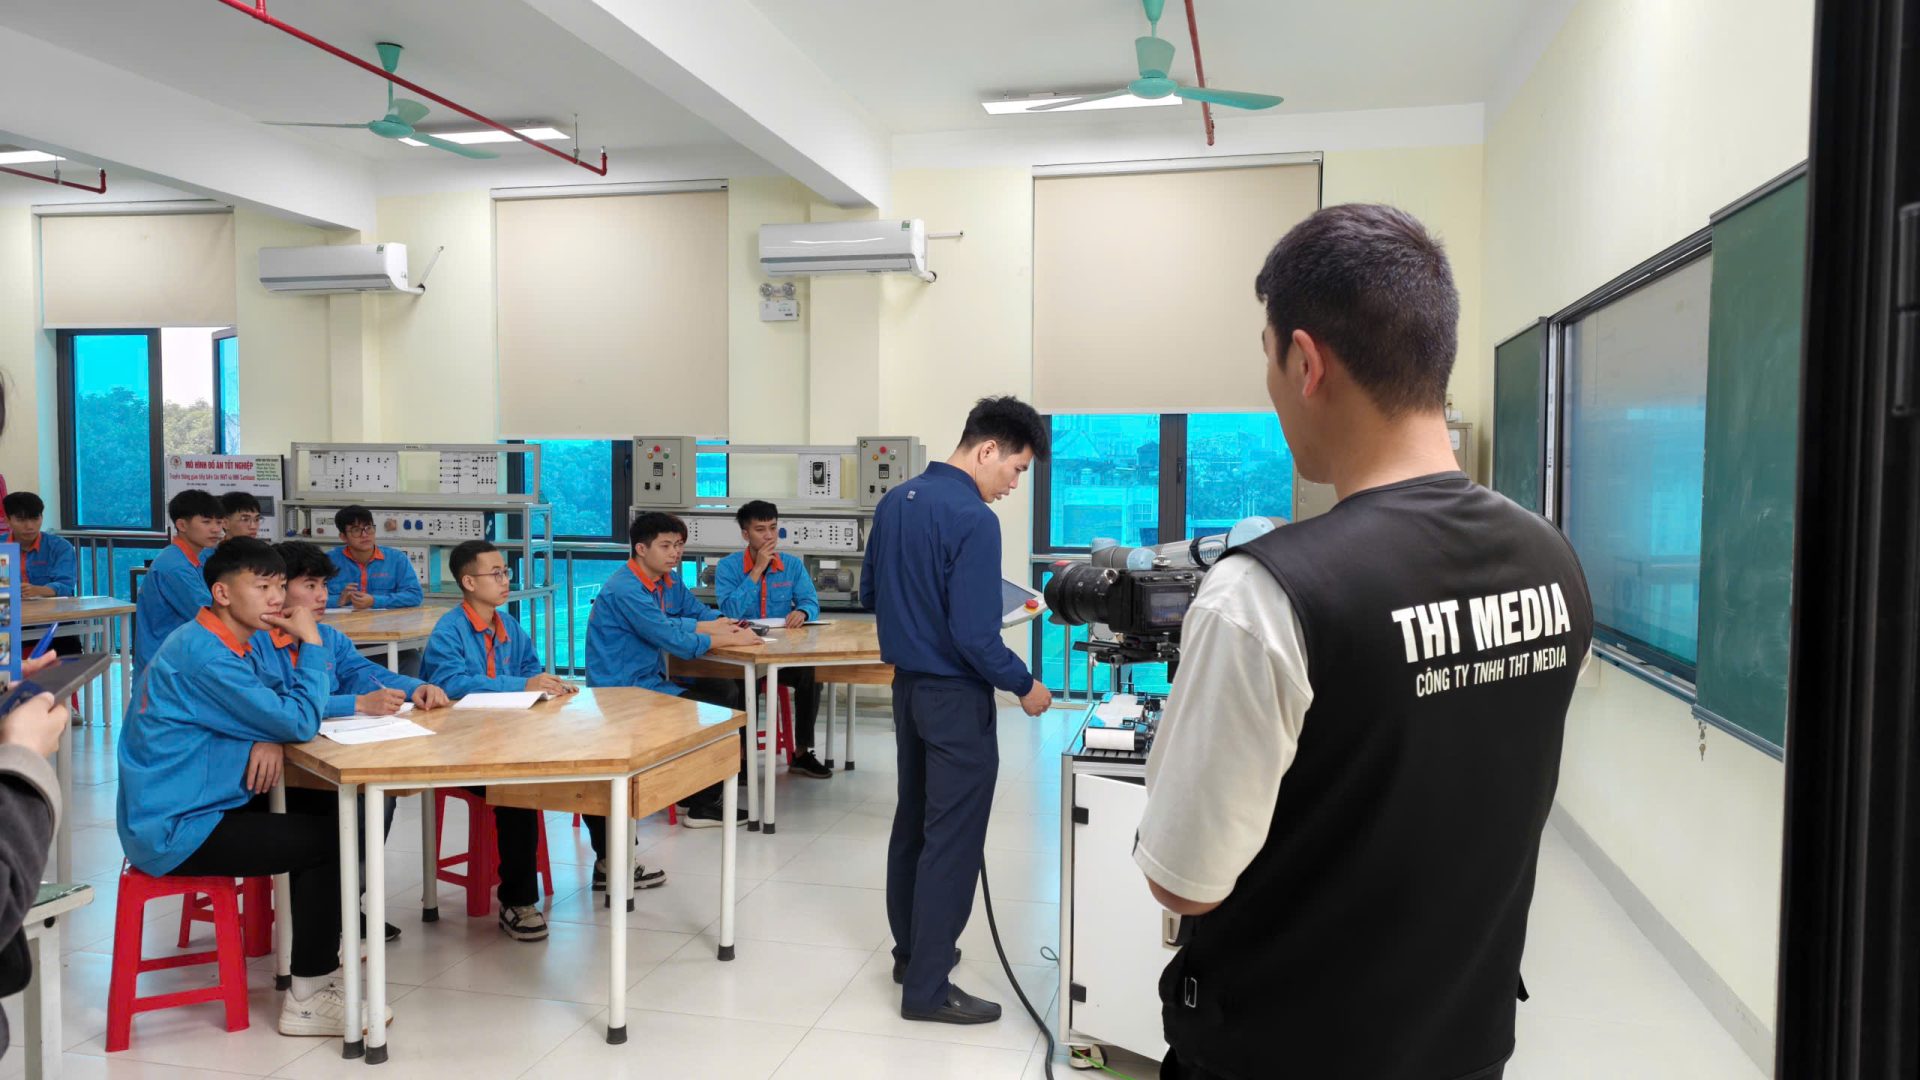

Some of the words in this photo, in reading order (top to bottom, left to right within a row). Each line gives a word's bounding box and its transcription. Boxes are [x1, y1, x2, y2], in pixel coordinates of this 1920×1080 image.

[195, 460, 207, 469] HÌNH
[234, 460, 253, 471] NGHIỆP
[1391, 599, 1460, 663] THT
[1469, 582, 1571, 651] MEDIA
[1416, 667, 1450, 698] CÔNG
[1454, 665, 1471, 688] TY
[1473, 660, 1504, 685] TNHH
[1508, 653, 1530, 680] THT
[1533, 645, 1567, 673] MEDIA
